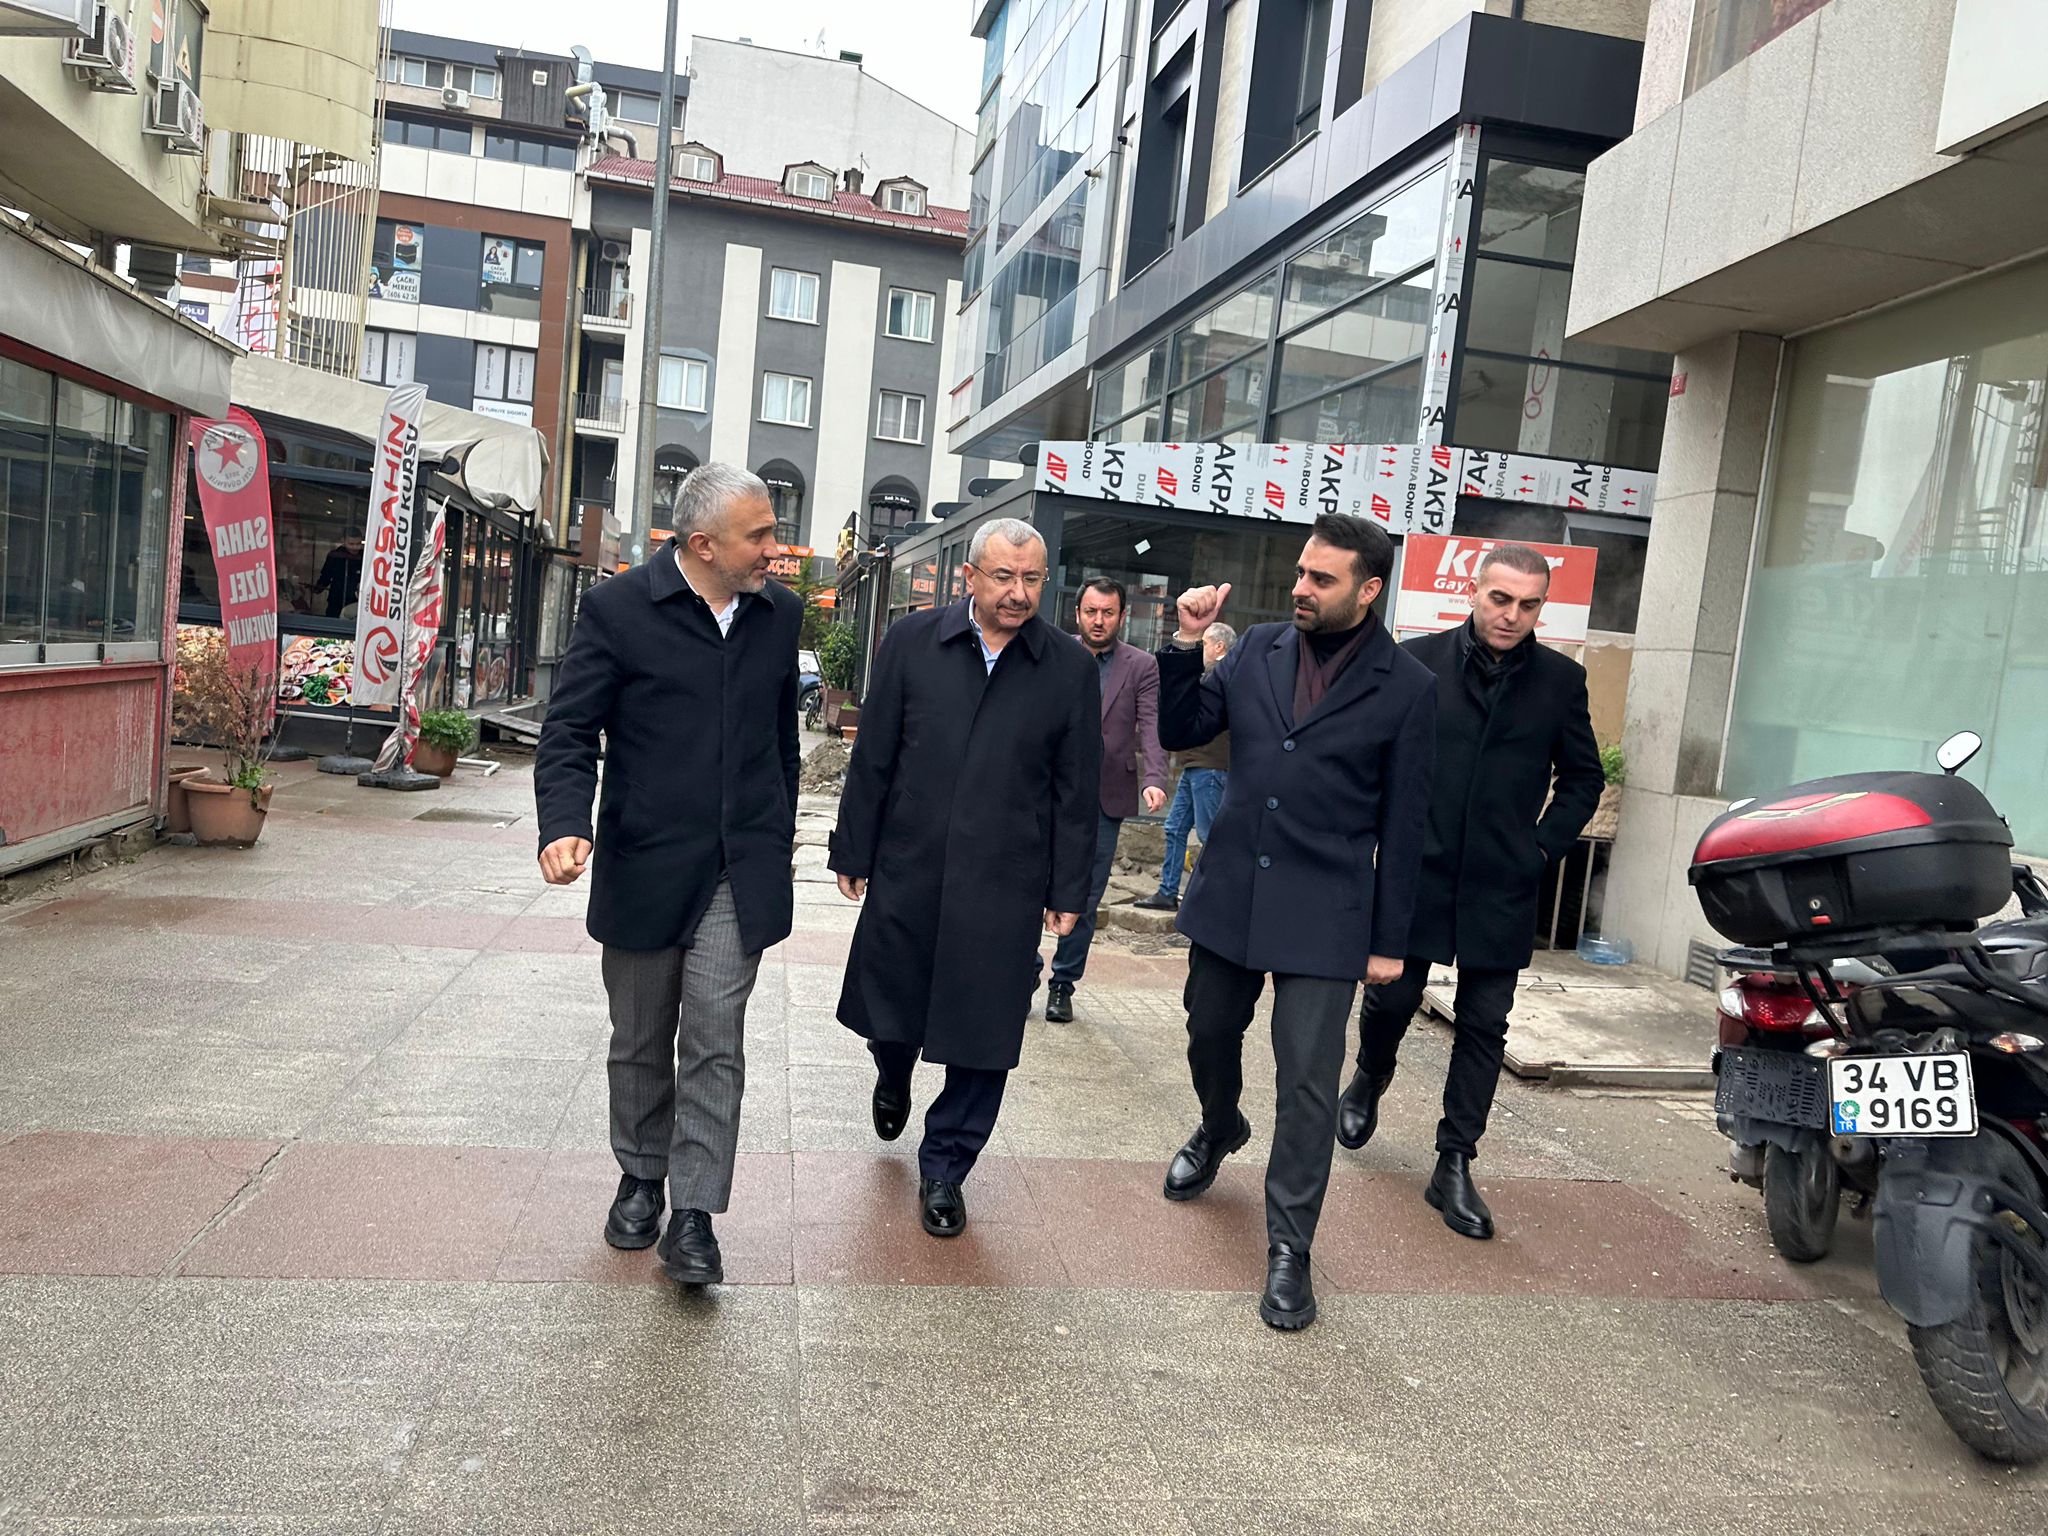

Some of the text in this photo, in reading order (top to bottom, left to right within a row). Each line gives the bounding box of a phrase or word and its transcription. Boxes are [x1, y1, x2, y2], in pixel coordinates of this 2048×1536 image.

[1317, 454, 1343, 516] AKP
[370, 413, 406, 618] ERŞAHİN
[389, 423, 419, 621] SÜRÜCÜ KURSU
[1843, 1060, 1959, 1094] 34 VB
[1839, 1120, 1854, 1131] TR
[1869, 1096, 1958, 1129] 9169
